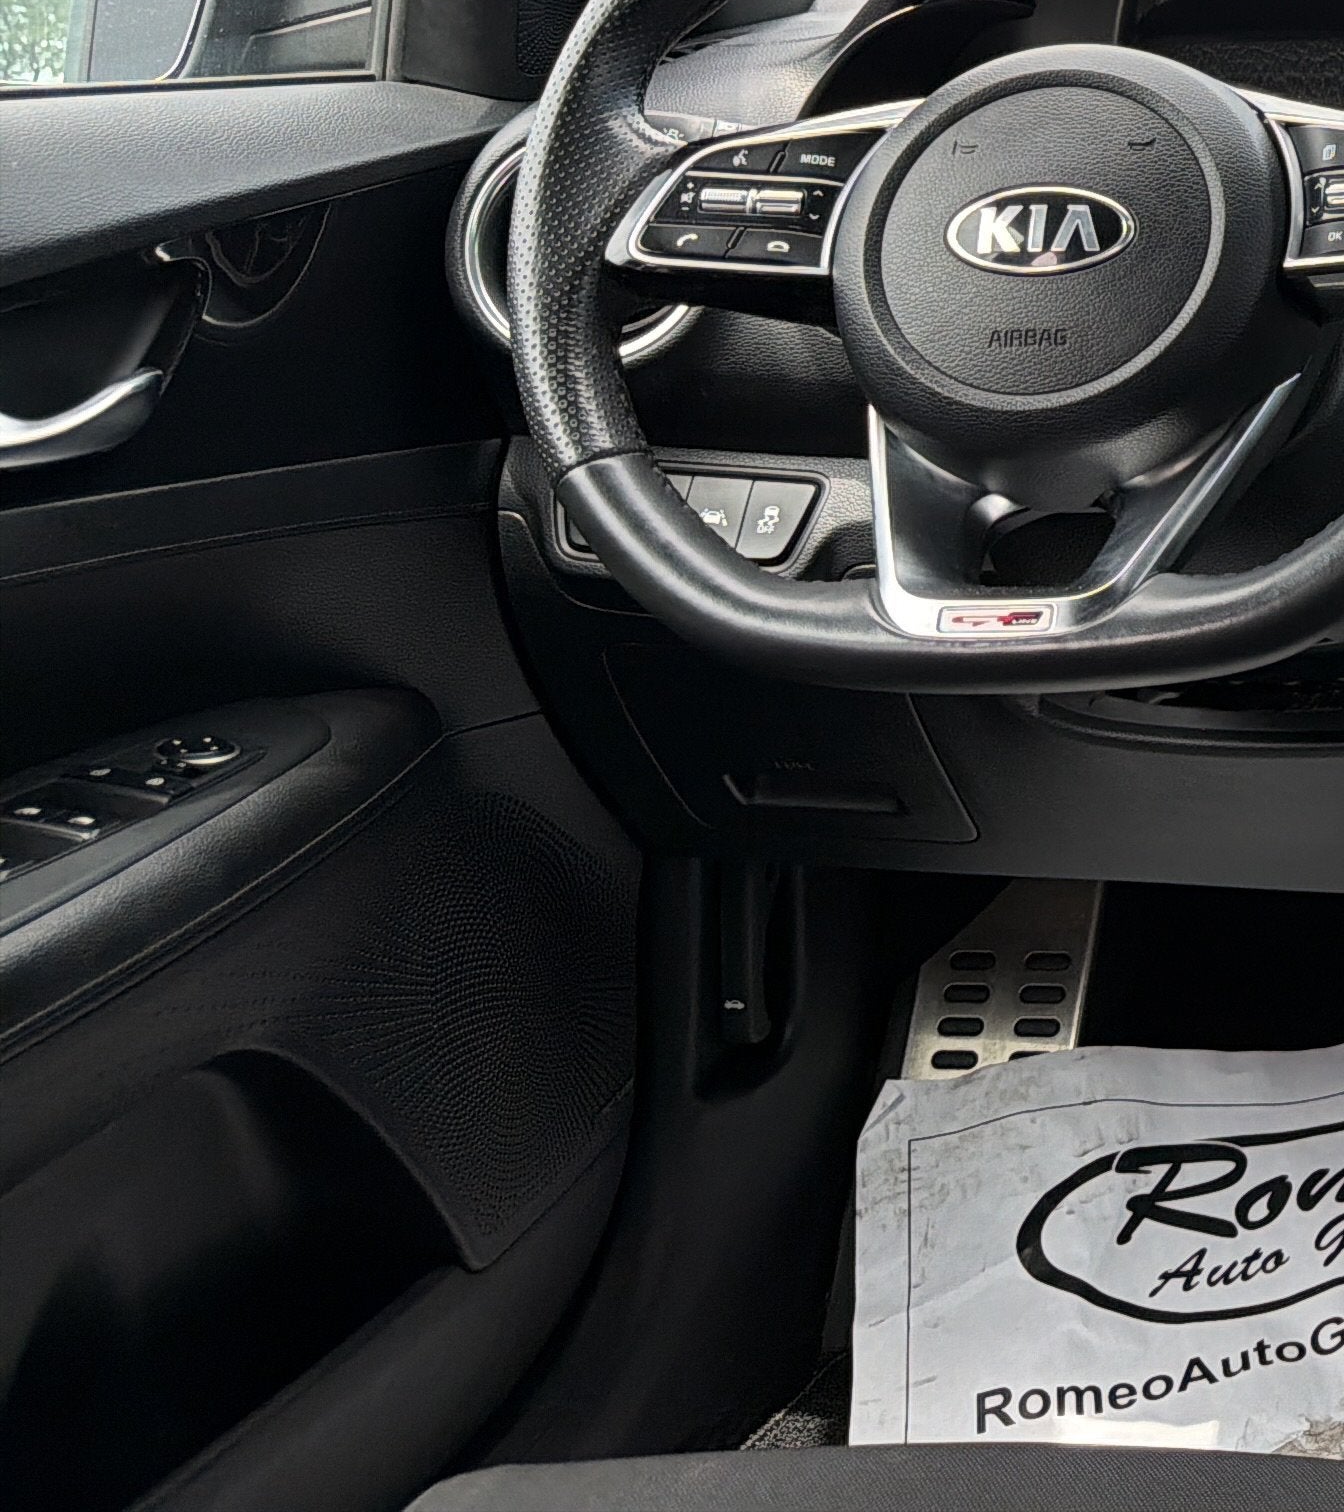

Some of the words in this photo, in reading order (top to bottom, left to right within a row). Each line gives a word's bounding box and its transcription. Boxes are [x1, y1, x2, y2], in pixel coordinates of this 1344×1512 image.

[800, 153, 837, 167] MODE
[976, 204, 1101, 254] KIA
[1327, 231, 1344, 242] OK
[988, 328, 1068, 349] AIRBAG
[1149, 1247, 1290, 1298] Auto
